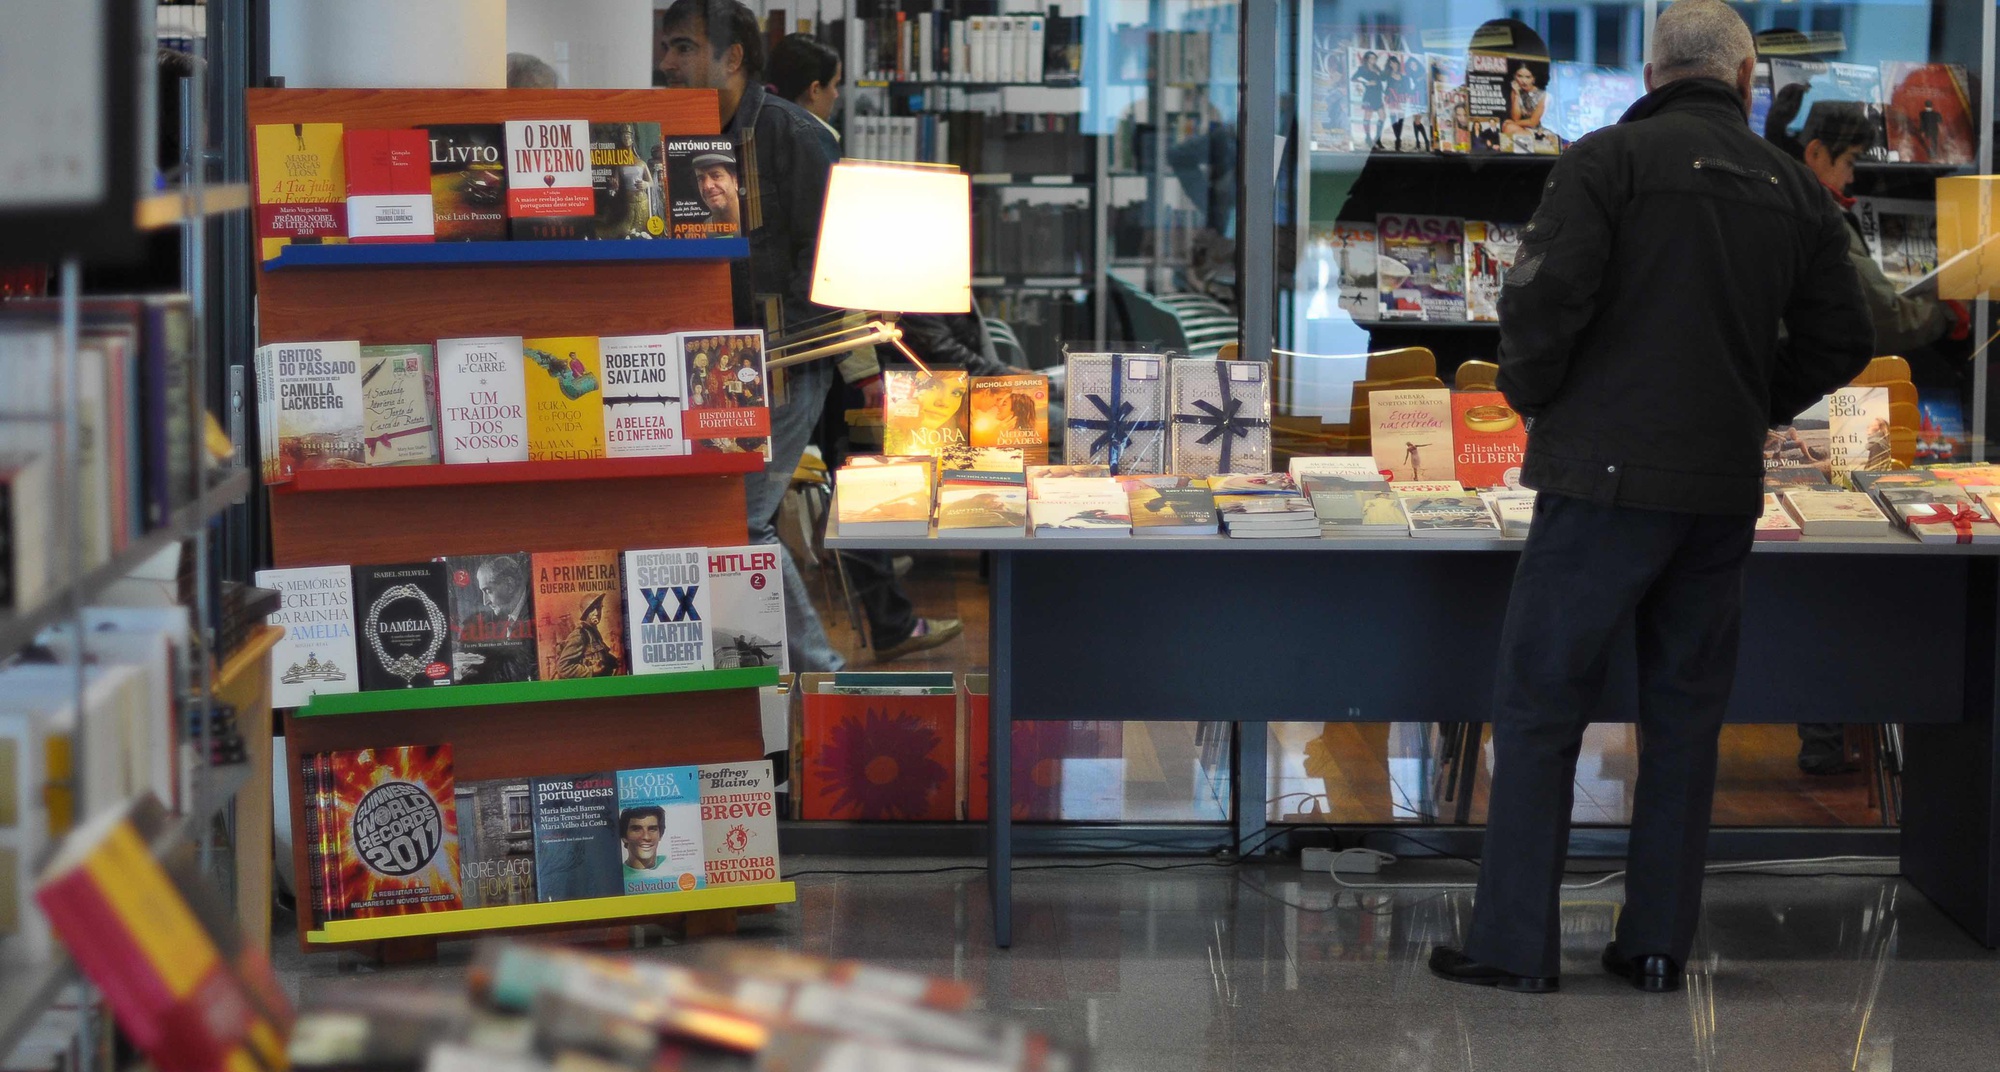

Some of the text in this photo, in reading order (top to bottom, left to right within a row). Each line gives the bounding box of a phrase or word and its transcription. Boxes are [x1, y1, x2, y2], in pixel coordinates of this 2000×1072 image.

[524, 124, 572, 148] O BOM
[429, 138, 499, 163] Livro
[668, 140, 732, 150] ANTÓNIO FEIO
[515, 147, 584, 173] INVERNO
[590, 150, 634, 165] AGUALUSA
[285, 161, 320, 169] VARGAS
[289, 168, 317, 176] LLOSA
[273, 180, 282, 192] A
[274, 213, 335, 222] PRÉMIO NOBEL
[435, 212, 452, 222] JOSÉ
[471, 212, 502, 220] PEIXOTO
[272, 221, 337, 229] DE LITERATURA
[674, 223, 738, 233] APROVEITEM
[1378, 216, 1463, 241] CASA
[279, 349, 322, 362] GRITOS
[466, 352, 498, 366] JOHN
[605, 353, 666, 368] ROBERTO
[279, 361, 356, 376] DO PASSADO
[458, 361, 506, 374] le CARRÉ
[607, 368, 666, 384] SAVIANO
[281, 382, 334, 397] CAMILLA
[976, 381, 1012, 389] NICHOLAS
[470, 391, 498, 406] UM
[447, 405, 523, 421] TRAIDOR
[538, 401, 567, 411] LUKA
[552, 411, 581, 421] FOGO
[699, 410, 756, 419] HISTÓRIA DE
[1389, 410, 1429, 421] Escrito
[470, 420, 503, 435] DOS
[556, 422, 583, 432] VIDA
[616, 416, 665, 429] A BELEZA
[700, 418, 756, 428] PORTUGAL
[1380, 416, 1444, 429] nas estrelas
[609, 428, 673, 442] E O INFERNO
[908, 427, 966, 446] NORA
[1000, 430, 1039, 438] MELODIA
[454, 434, 519, 451] NOSSOS
[528, 440, 574, 450] SALMAN
[997, 437, 1043, 446] DO ADEUS
[1464, 443, 1520, 453] Elizabeth
[528, 449, 602, 460] RUSHDIE
[1458, 453, 1525, 464] GILBERT
[1780, 458, 1800, 467] Vou
[636, 552, 699, 566] HISTÓRIA DO
[708, 553, 777, 573] HITLER
[374, 571, 397, 579] ISABEL
[541, 564, 616, 582] A PRIMEIRA
[637, 564, 700, 587] SÉCULO
[271, 577, 347, 591] AS MEMÓRIAS
[540, 580, 616, 594] GUERRA MUNDIAL
[281, 591, 348, 609] ECRETAS
[640, 586, 702, 624] XX
[271, 608, 349, 624] DA RAINHA
[291, 622, 351, 641] AMÉLIA
[641, 622, 703, 644] MARTIN
[642, 642, 703, 664] GILBERT
[698, 768, 749, 780] Geoffrey
[538, 781, 573, 792] novas
[620, 772, 674, 791] LIÇÕES
[711, 778, 760, 789] Blainey
[539, 788, 614, 805] portuguesas
[620, 784, 681, 800] DE VIDA
[357, 785, 420, 823] GUINNESS
[560, 805, 578, 813] Isabel
[357, 794, 430, 838] WORLD
[540, 815, 559, 823] Maria
[359, 805, 436, 851] RECORDS
[366, 817, 439, 872] 2011
[460, 858, 530, 879] NDRÉ GAGO
[711, 868, 775, 884] MUNDO
[479, 874, 532, 896] HOMEM
[628, 879, 676, 892] Salvador
[379, 889, 412, 897] REBENTAR
[351, 900, 384, 908] MILHARES
[397, 896, 419, 904] NOVOS
[420, 894, 454, 902] RECORDES
